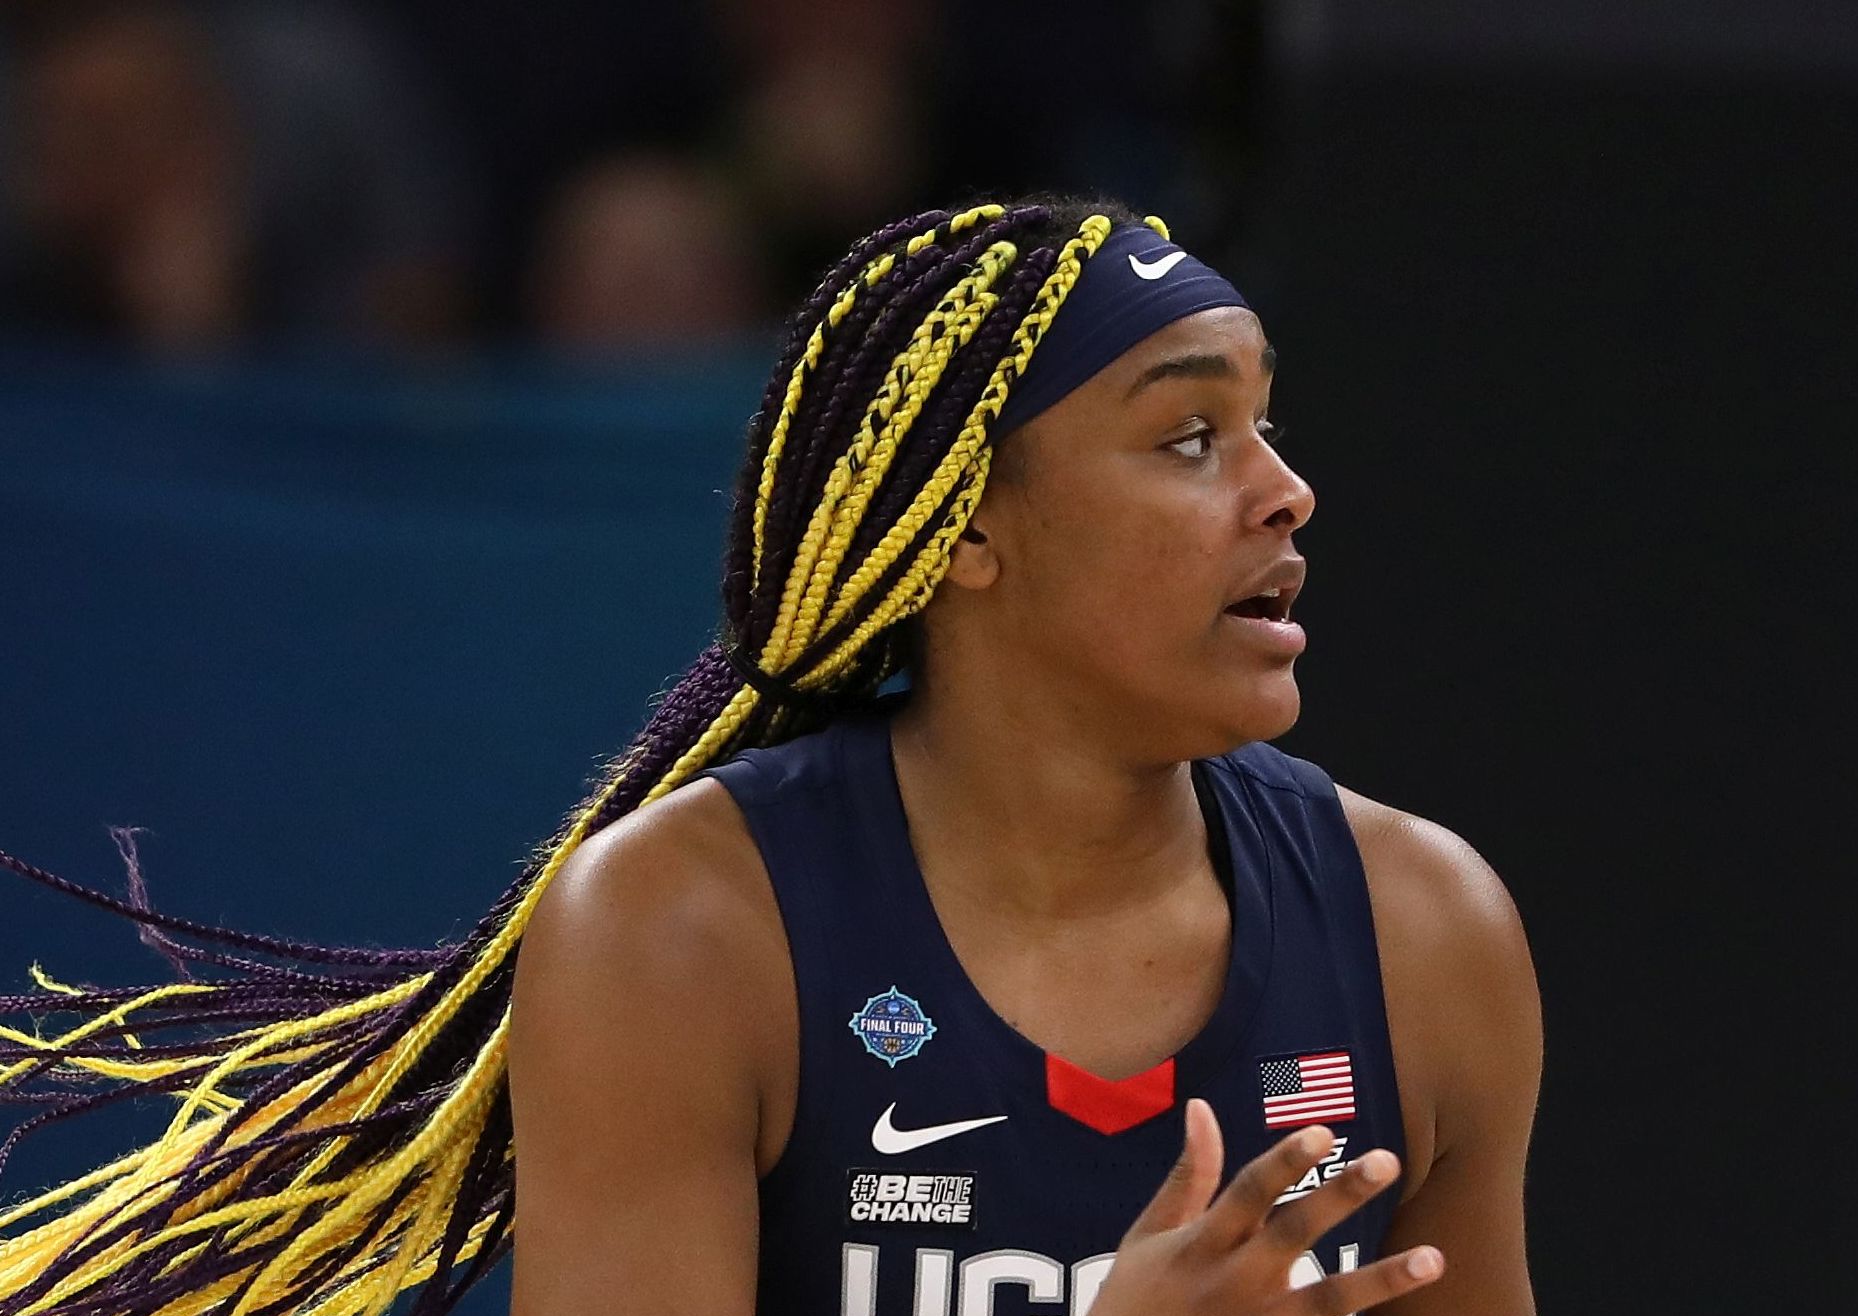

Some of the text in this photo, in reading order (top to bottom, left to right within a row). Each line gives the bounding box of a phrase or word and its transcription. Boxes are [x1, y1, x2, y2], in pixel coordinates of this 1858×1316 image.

[860, 1018, 925, 1035] FINAL FOUR
[850, 1201, 972, 1224] CHANGE
